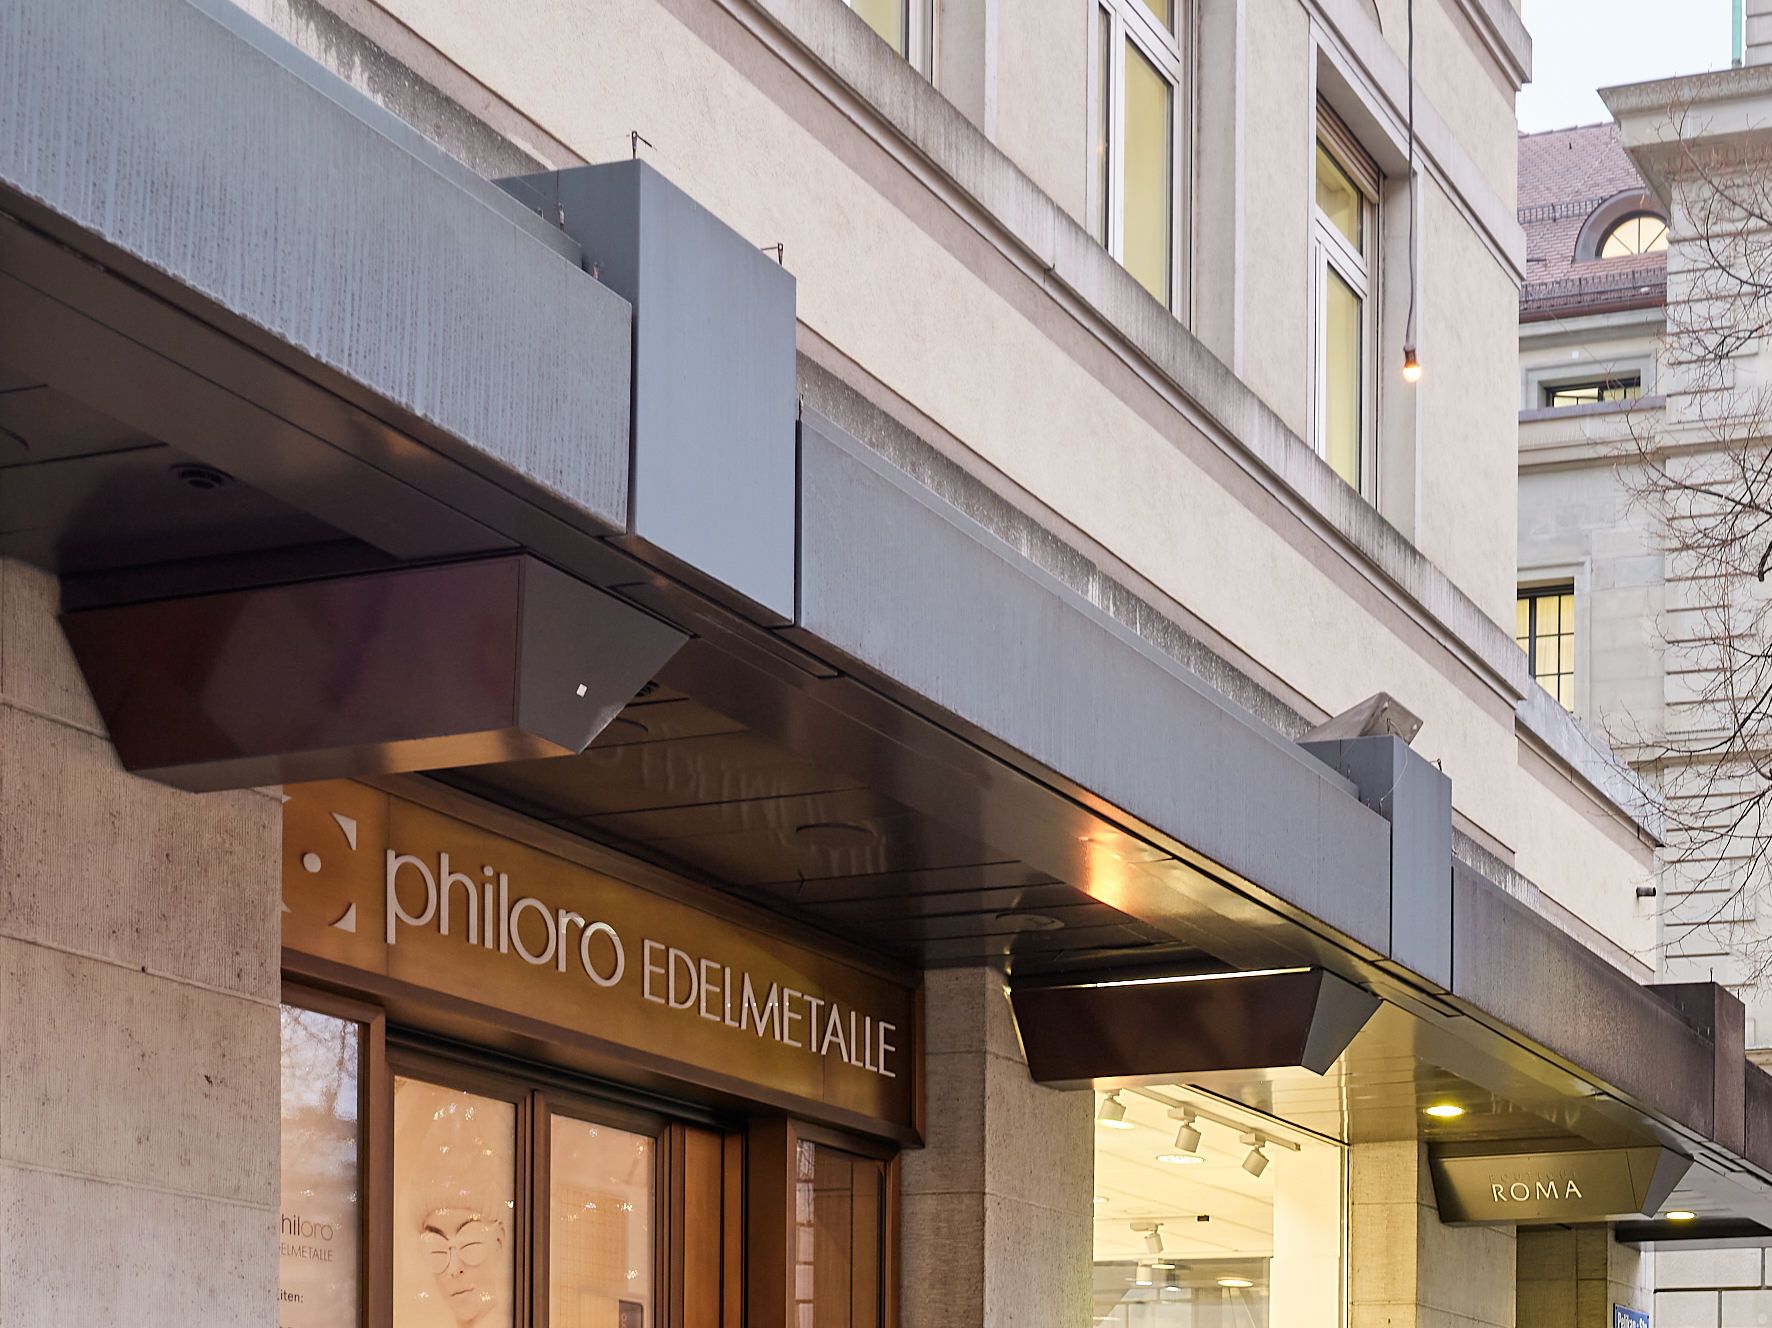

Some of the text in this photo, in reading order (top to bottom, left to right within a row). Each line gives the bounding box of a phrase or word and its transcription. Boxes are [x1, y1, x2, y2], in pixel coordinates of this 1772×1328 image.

[386, 848, 898, 1078] philoro EDELMETALLE
[1490, 1179, 1583, 1202] ROMA
[281, 1213, 334, 1241] hiloro
[279, 1242, 333, 1263] ELMETALLE
